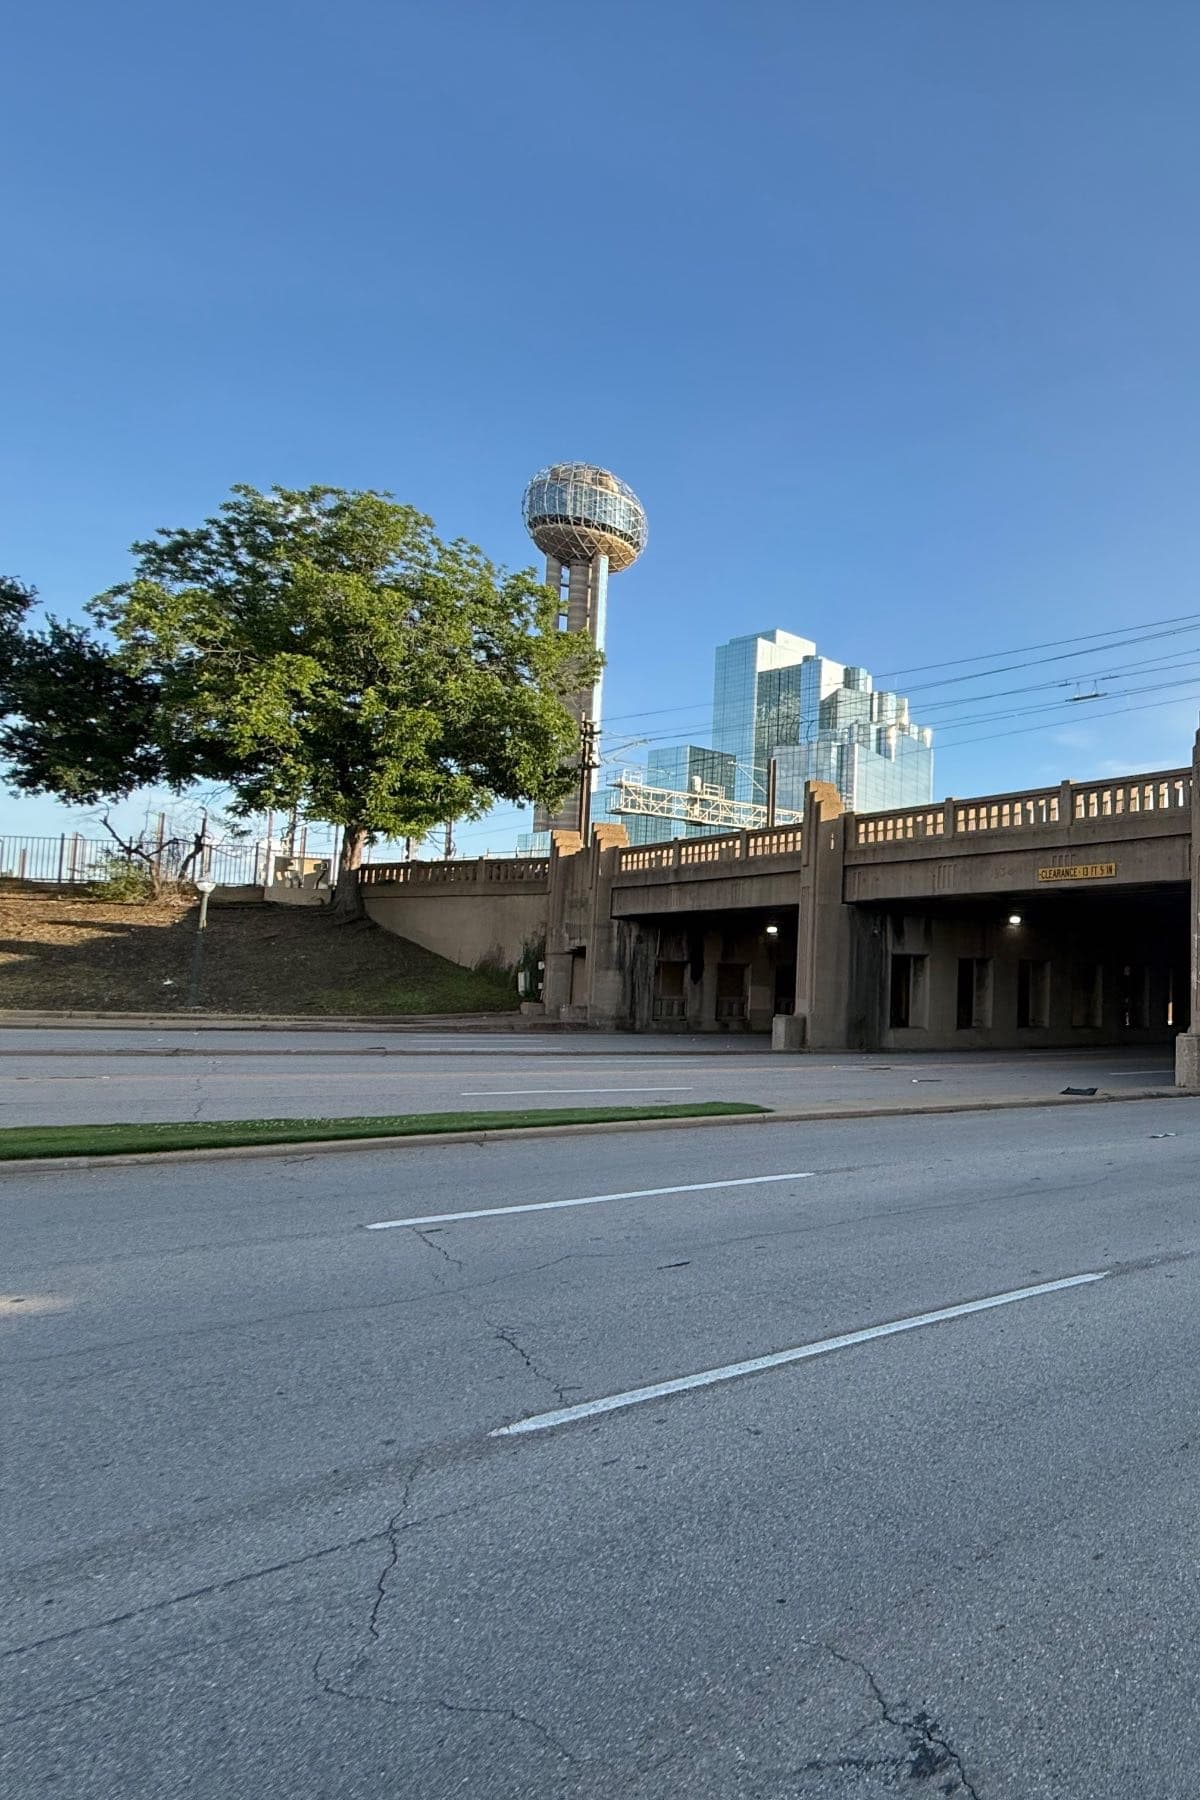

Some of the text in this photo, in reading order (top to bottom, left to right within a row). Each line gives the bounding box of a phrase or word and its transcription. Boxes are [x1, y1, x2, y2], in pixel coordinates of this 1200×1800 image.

[1041, 867, 1077, 879] CLEARANCE
[1091, 866, 1097, 876] FT
[1106, 864, 1112, 874] IN
